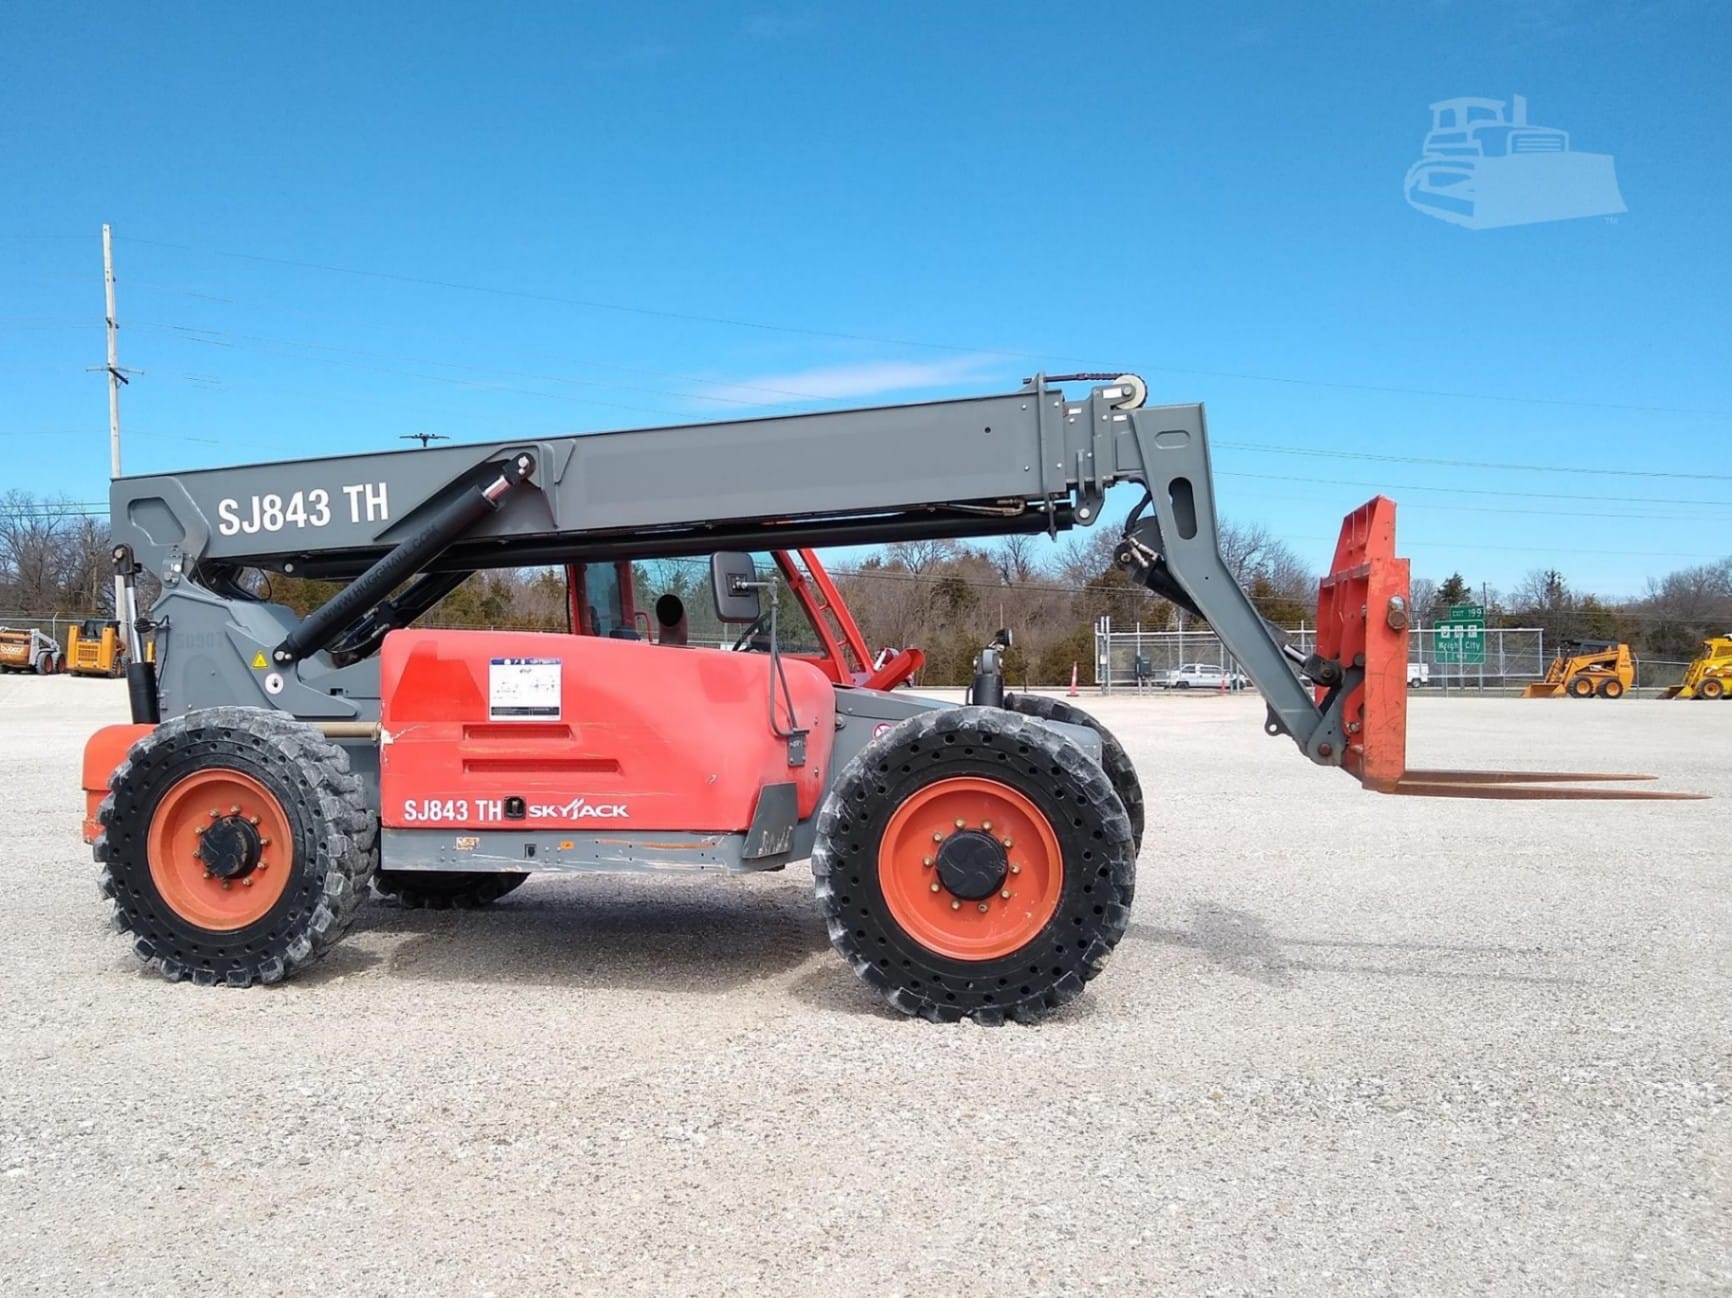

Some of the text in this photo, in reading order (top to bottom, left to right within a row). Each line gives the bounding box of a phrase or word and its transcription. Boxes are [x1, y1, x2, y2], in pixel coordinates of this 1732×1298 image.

[218, 482, 389, 536] SJ843 TH
[1468, 608, 1482, 617] 199
[1465, 640, 1480, 651] City
[404, 799, 469, 821] SJ843
[475, 799, 502, 821] TH
[528, 798, 629, 821] SKYJACK
